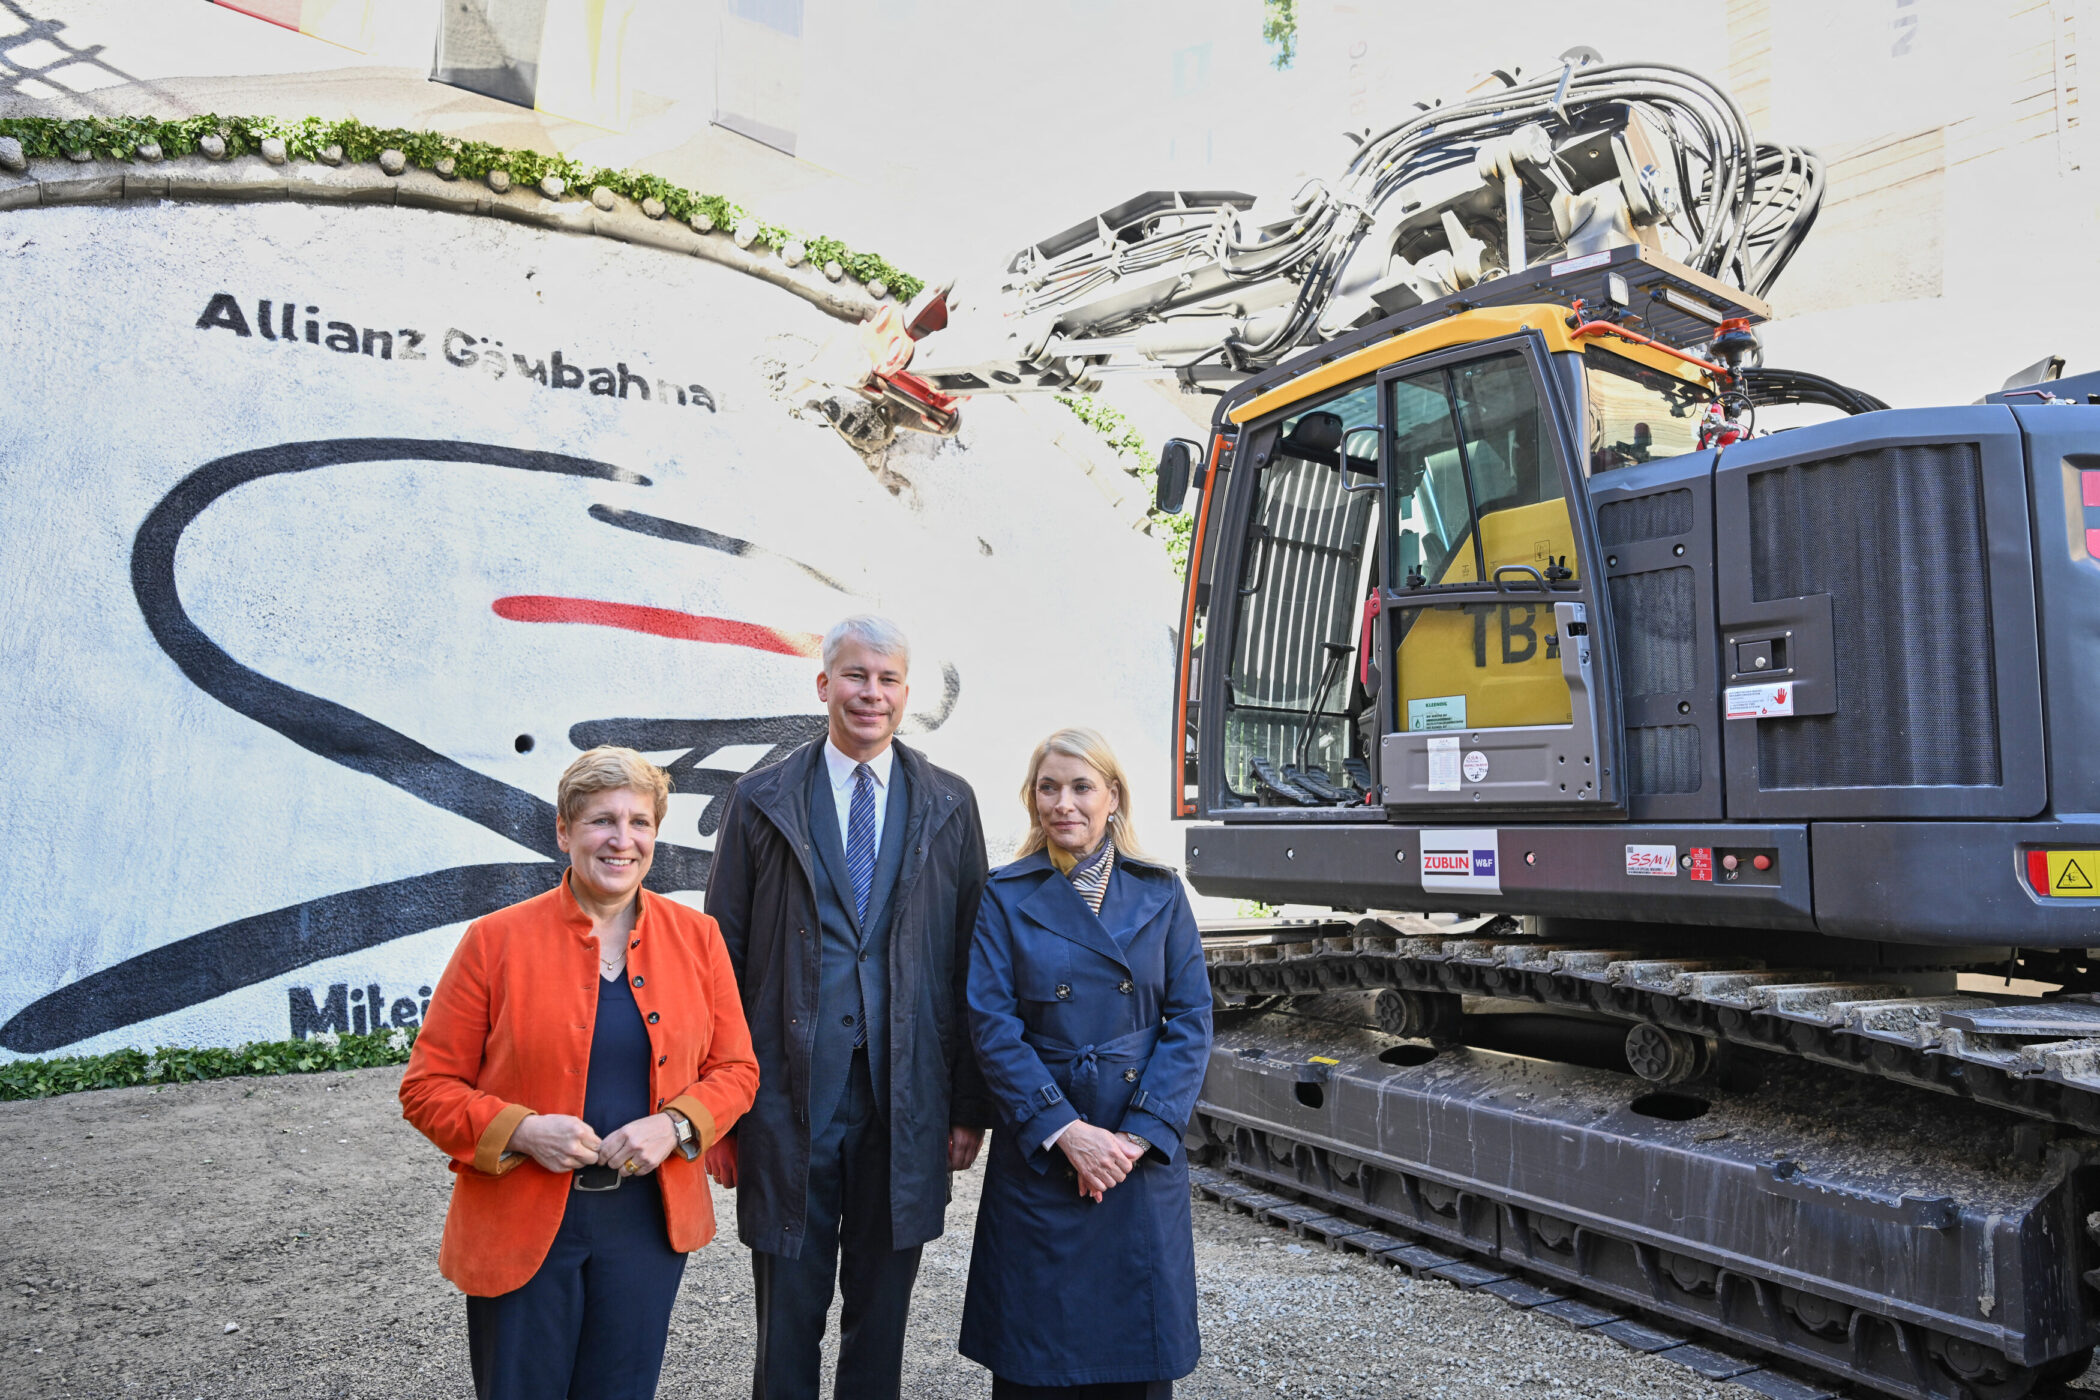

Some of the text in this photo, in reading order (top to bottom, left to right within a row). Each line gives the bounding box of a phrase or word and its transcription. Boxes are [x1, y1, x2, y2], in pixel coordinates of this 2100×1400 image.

[196, 293, 427, 360] Allianz
[1424, 856, 1493, 869] ZÜBLIN W&F
[1627, 853, 1662, 867] SSM
